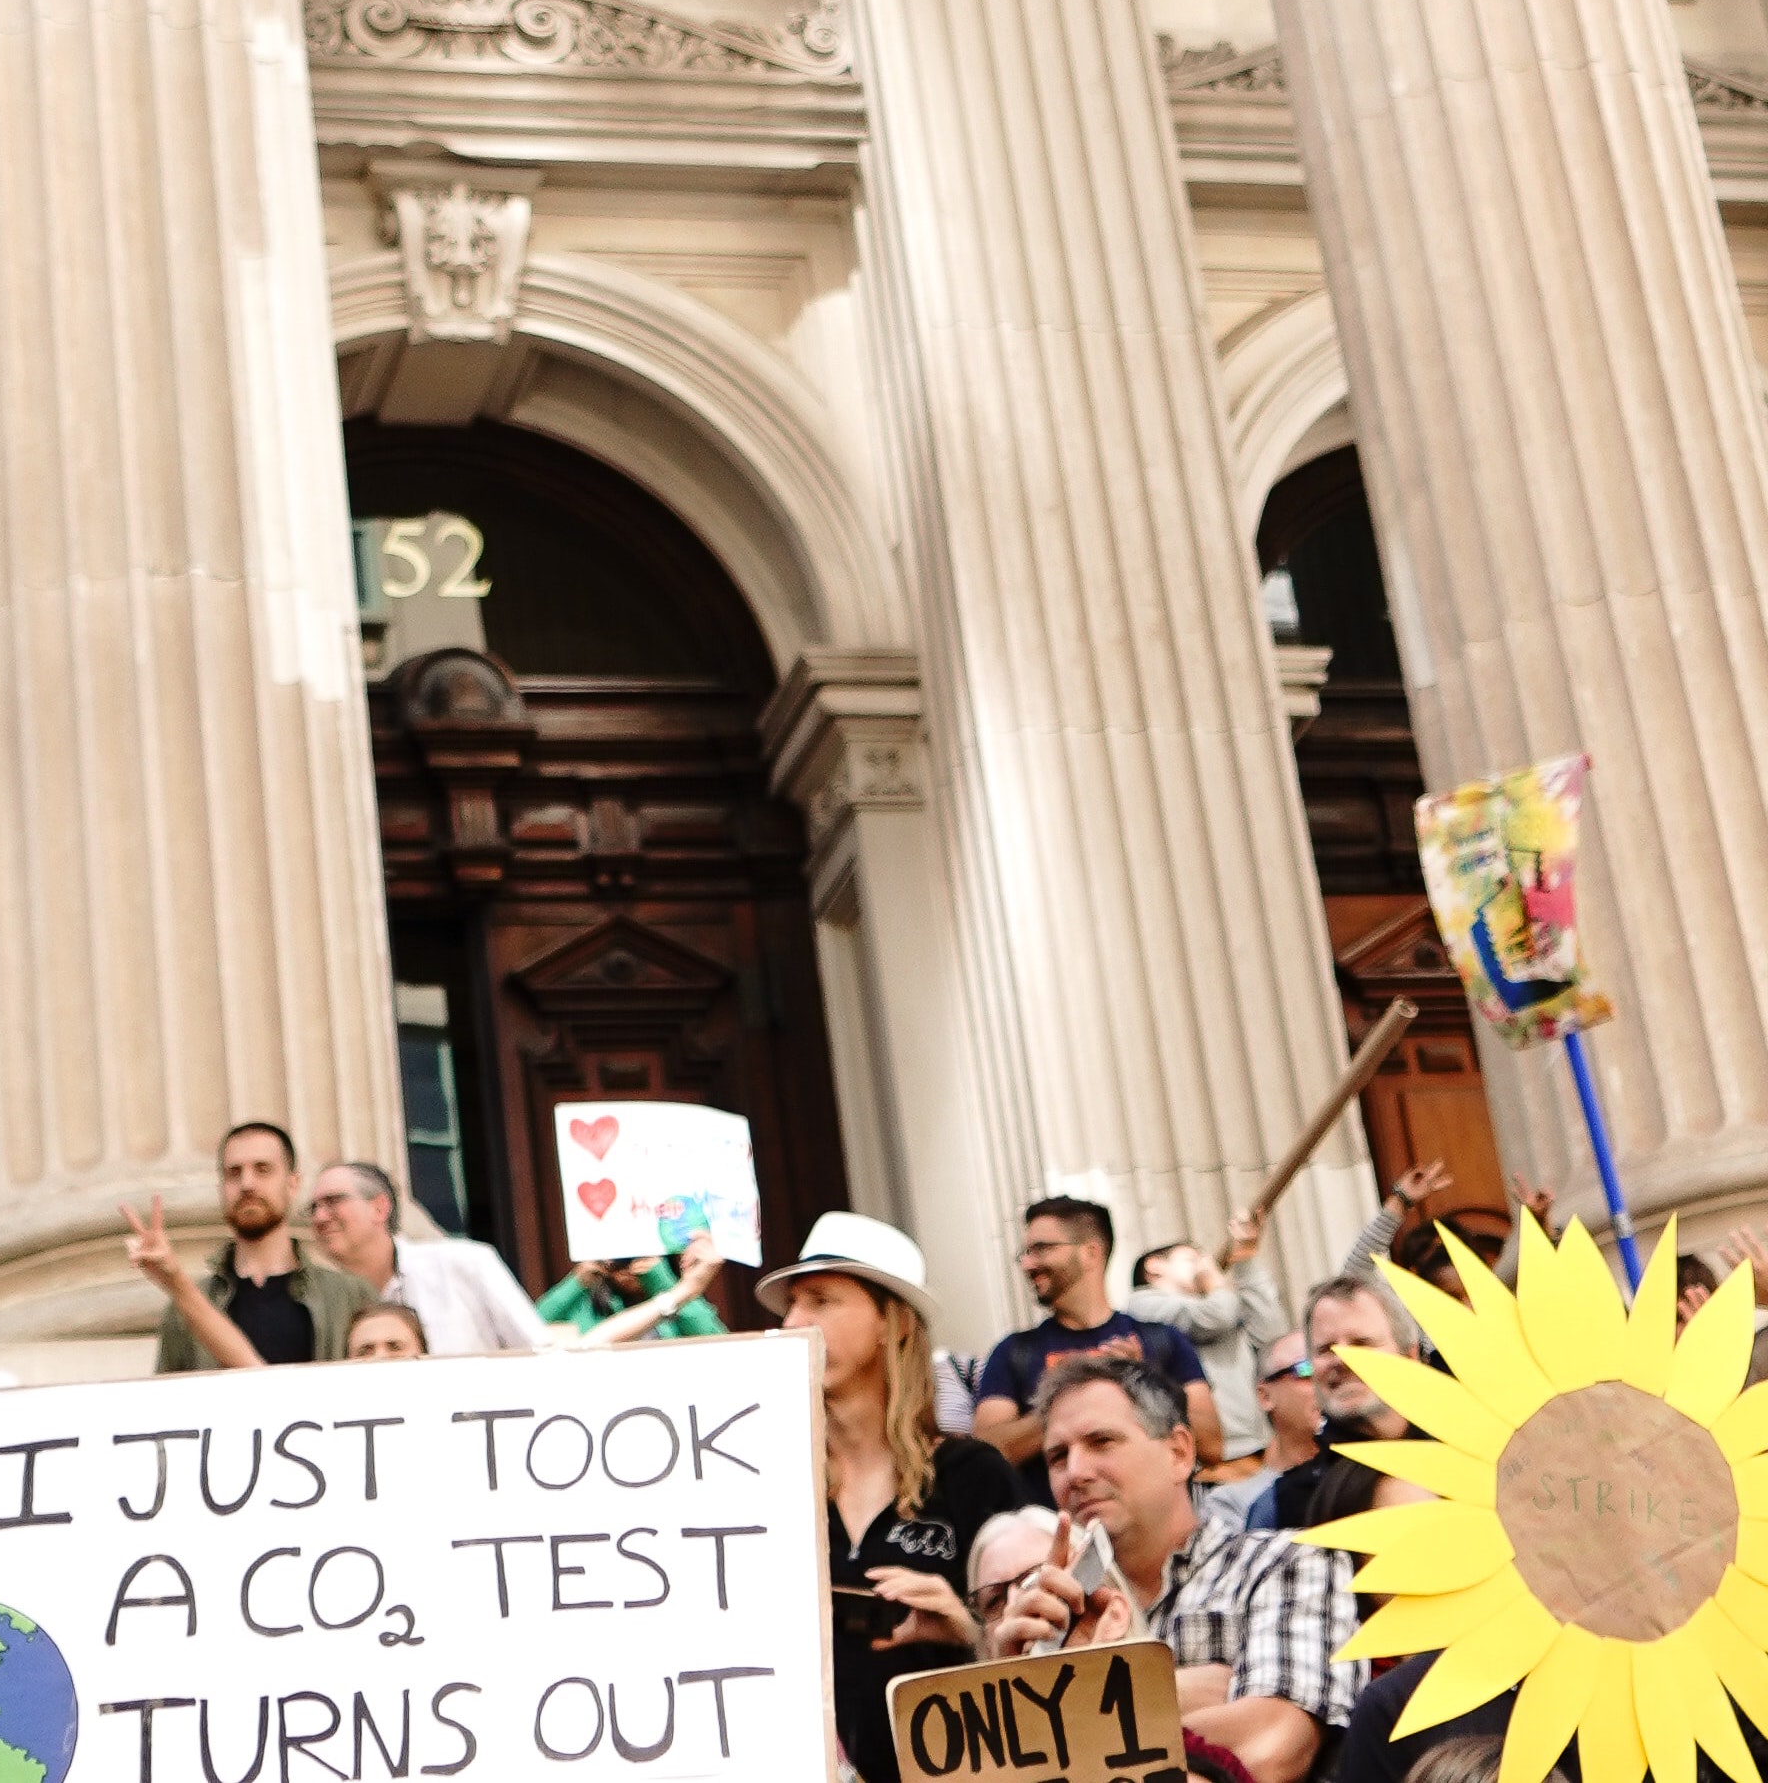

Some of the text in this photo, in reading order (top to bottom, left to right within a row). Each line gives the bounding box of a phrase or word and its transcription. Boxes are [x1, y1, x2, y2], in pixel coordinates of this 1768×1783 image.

[382, 519, 493, 599] 52
[113, 1417, 405, 1521] JUST
[451, 1403, 761, 1491] TOOK
[1532, 1473, 1702, 1537] STRIKE
[105, 1553, 198, 1645] A
[451, 1525, 768, 1618] TEST
[98, 1666, 775, 1783] TURNS OUT
[910, 1654, 1169, 1777] ONLY 1
